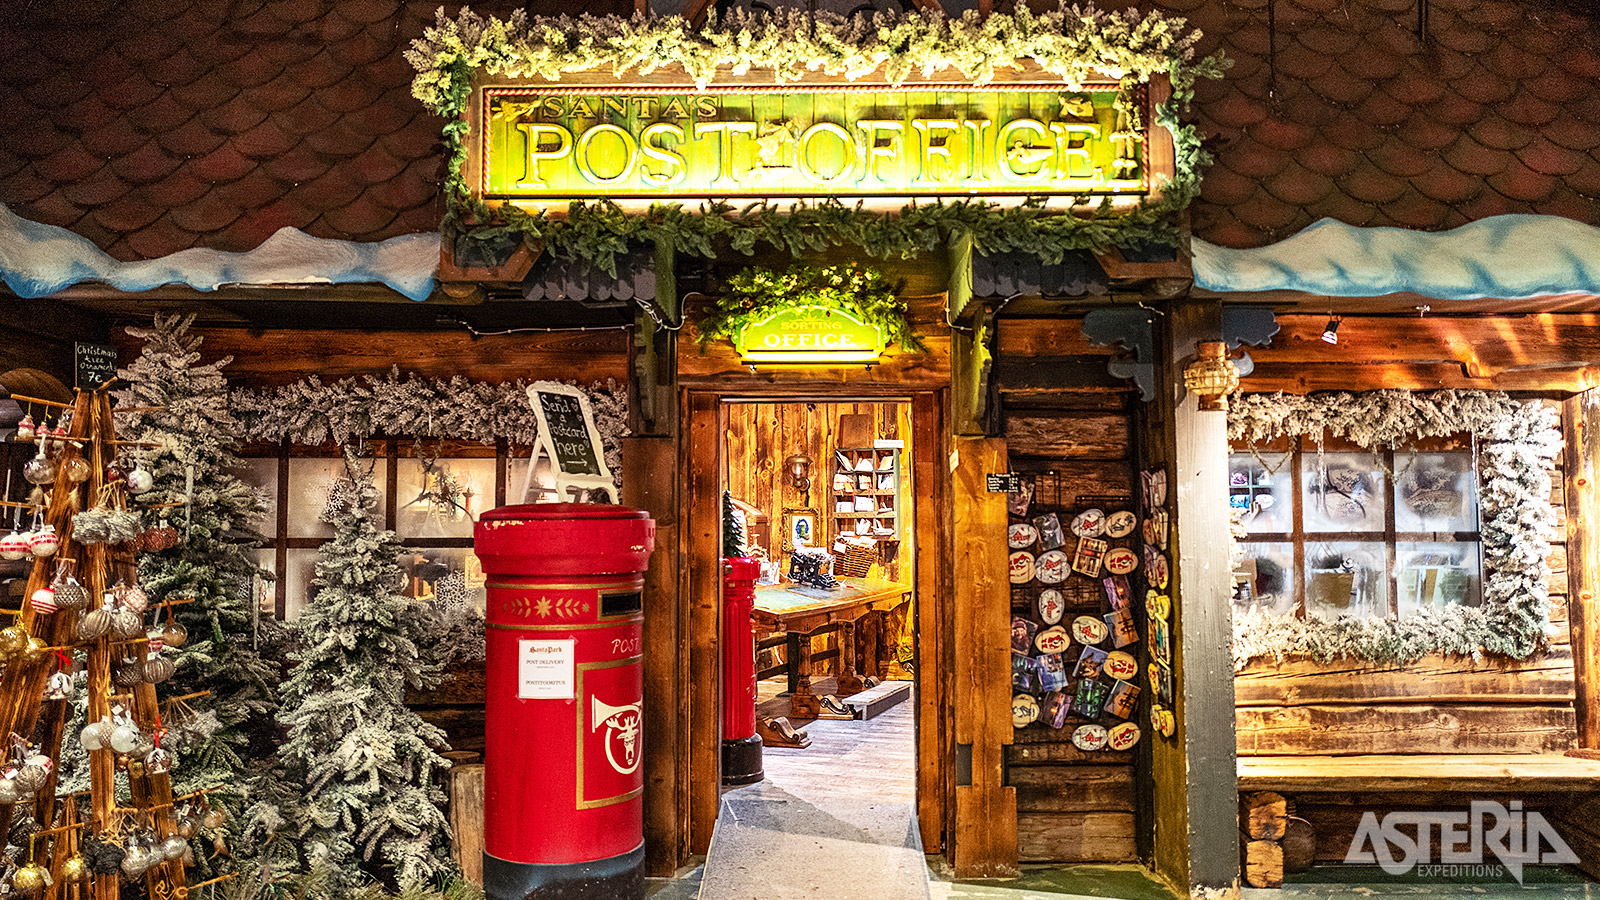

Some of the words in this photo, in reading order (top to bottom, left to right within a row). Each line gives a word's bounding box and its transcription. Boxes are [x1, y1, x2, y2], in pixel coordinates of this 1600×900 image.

[543, 95, 719, 119] SANTA'S
[515, 121, 757, 188] POST
[795, 118, 1103, 188] OFFICE
[780, 321, 843, 331] SORTING
[763, 334, 857, 347] OFFICE
[77, 345, 117, 359] Christmas
[84, 355, 105, 364] tree
[87, 371, 103, 383] 7€
[541, 394, 571, 413] Send
[560, 414, 567, 423] a
[553, 437, 587, 456] here
[529, 645, 563, 654] SantaPark
[611, 637, 639, 654] POST
